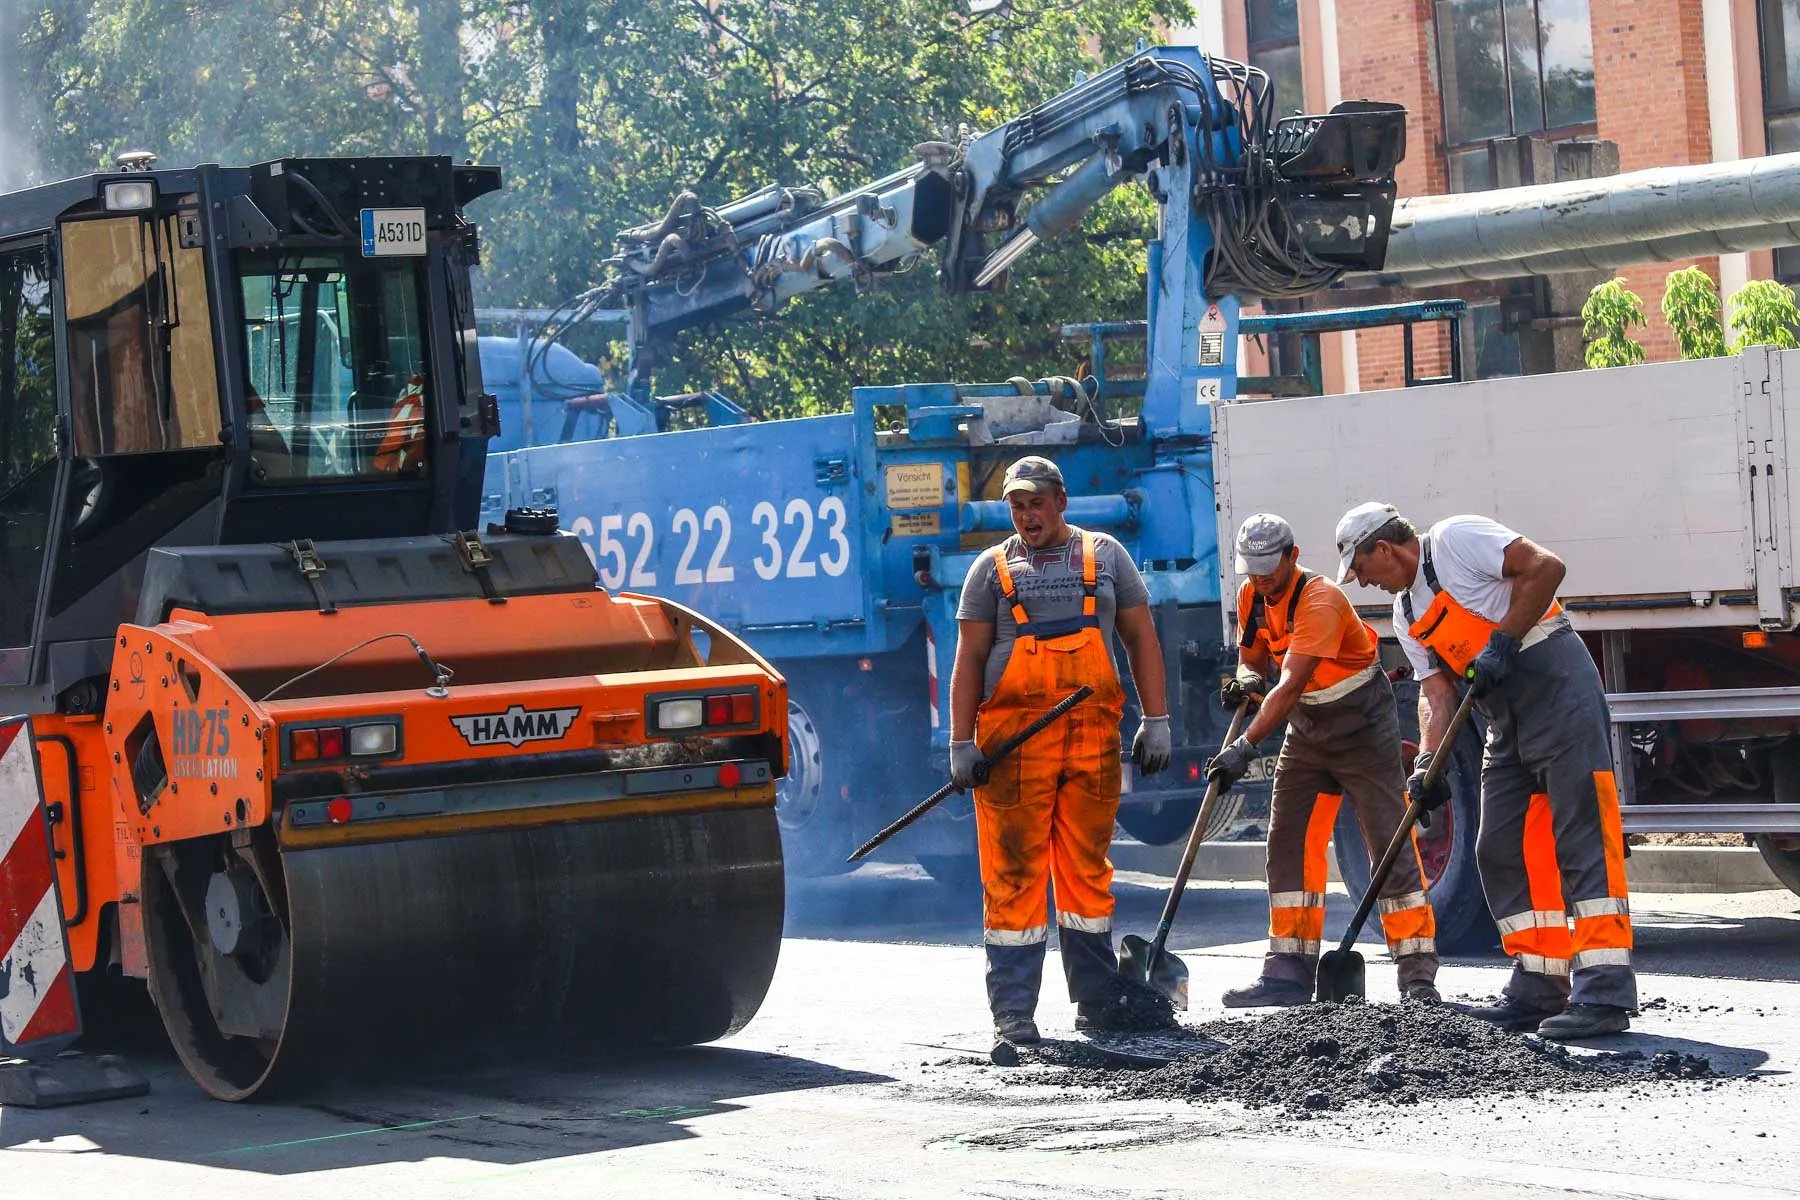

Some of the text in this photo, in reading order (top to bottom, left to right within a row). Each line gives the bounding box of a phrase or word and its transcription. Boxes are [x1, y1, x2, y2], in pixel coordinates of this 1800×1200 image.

[378, 222, 422, 243] A531D
[1200, 385, 1216, 398] CE
[896, 472, 932, 482] Vorsicht
[672, 505, 735, 585] 22
[751, 496, 850, 581] 323
[473, 713, 559, 741] HAMM
